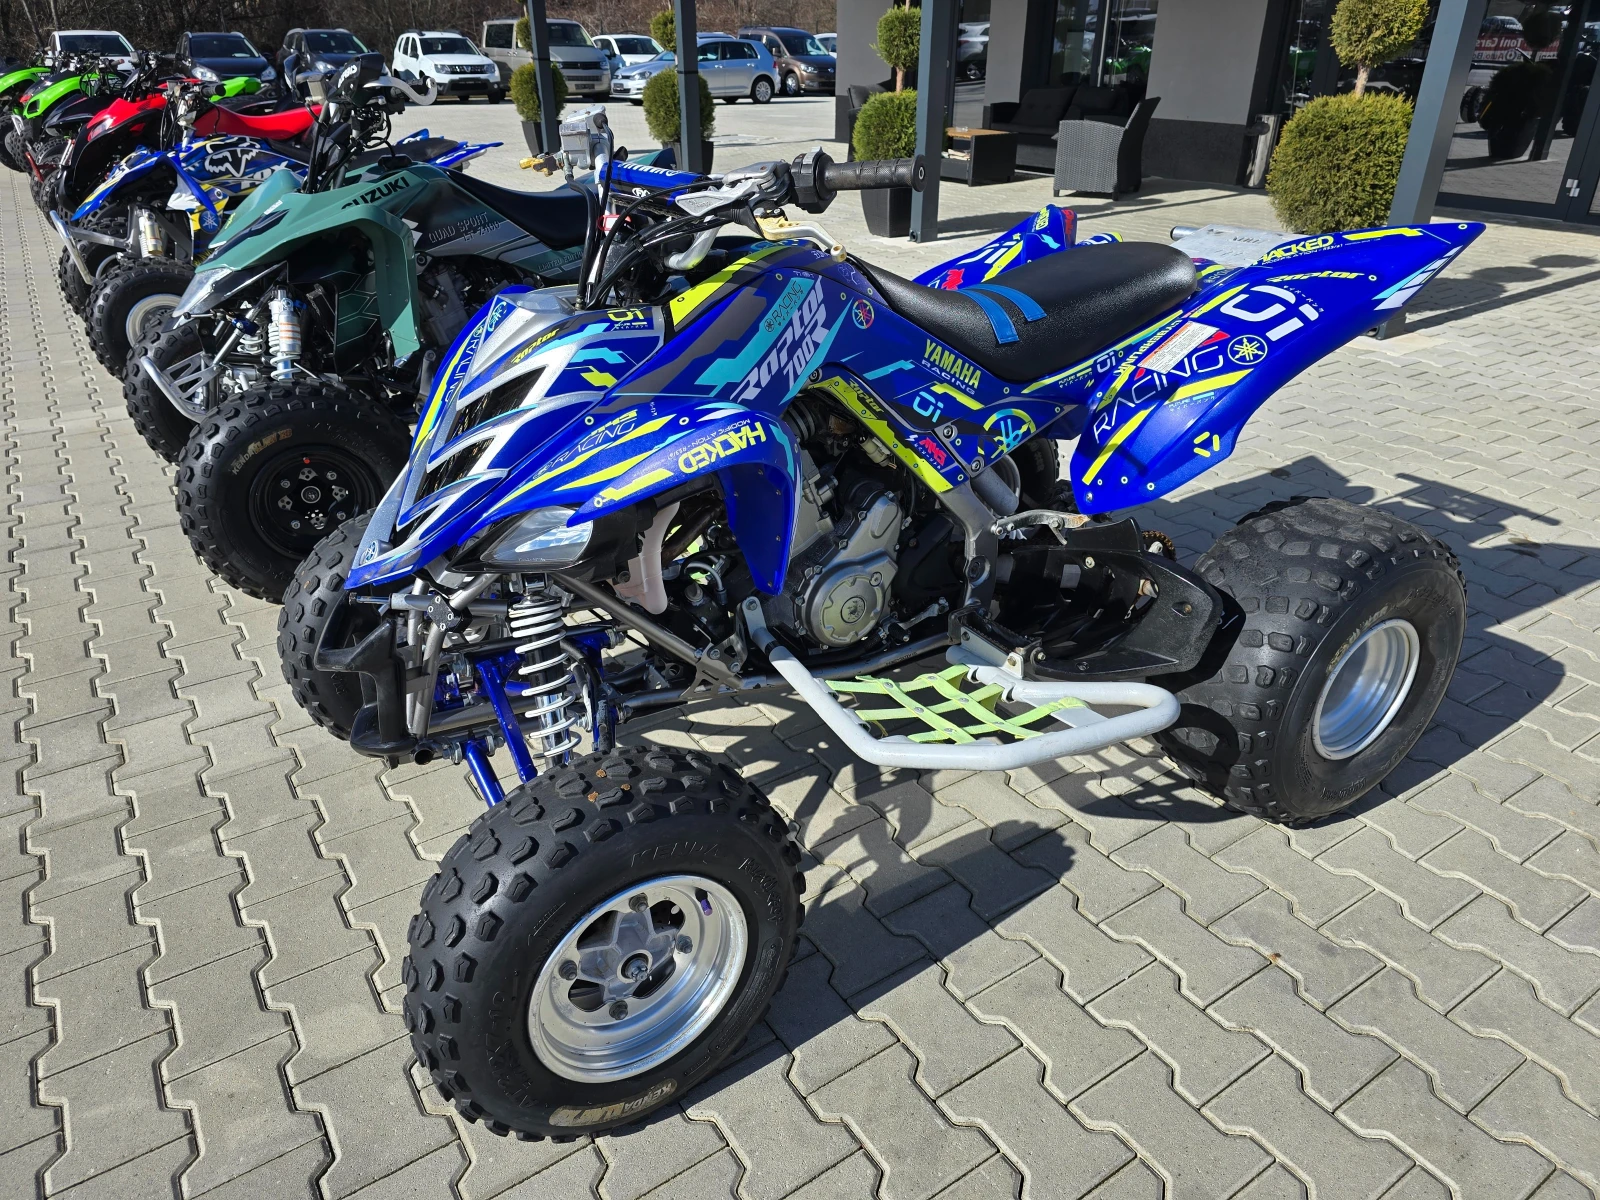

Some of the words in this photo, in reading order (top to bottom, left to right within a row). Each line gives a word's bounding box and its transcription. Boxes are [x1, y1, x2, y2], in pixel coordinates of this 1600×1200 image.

[1252, 235, 1334, 267] HACKED
[772, 280, 802, 326] RACING
[729, 275, 825, 403] Raptor
[783, 303, 830, 391] 700R
[923, 339, 982, 390] YAMAHA
[921, 359, 977, 395] RACING
[1093, 346, 1224, 444] RACING
[677, 421, 767, 474] HACKED
